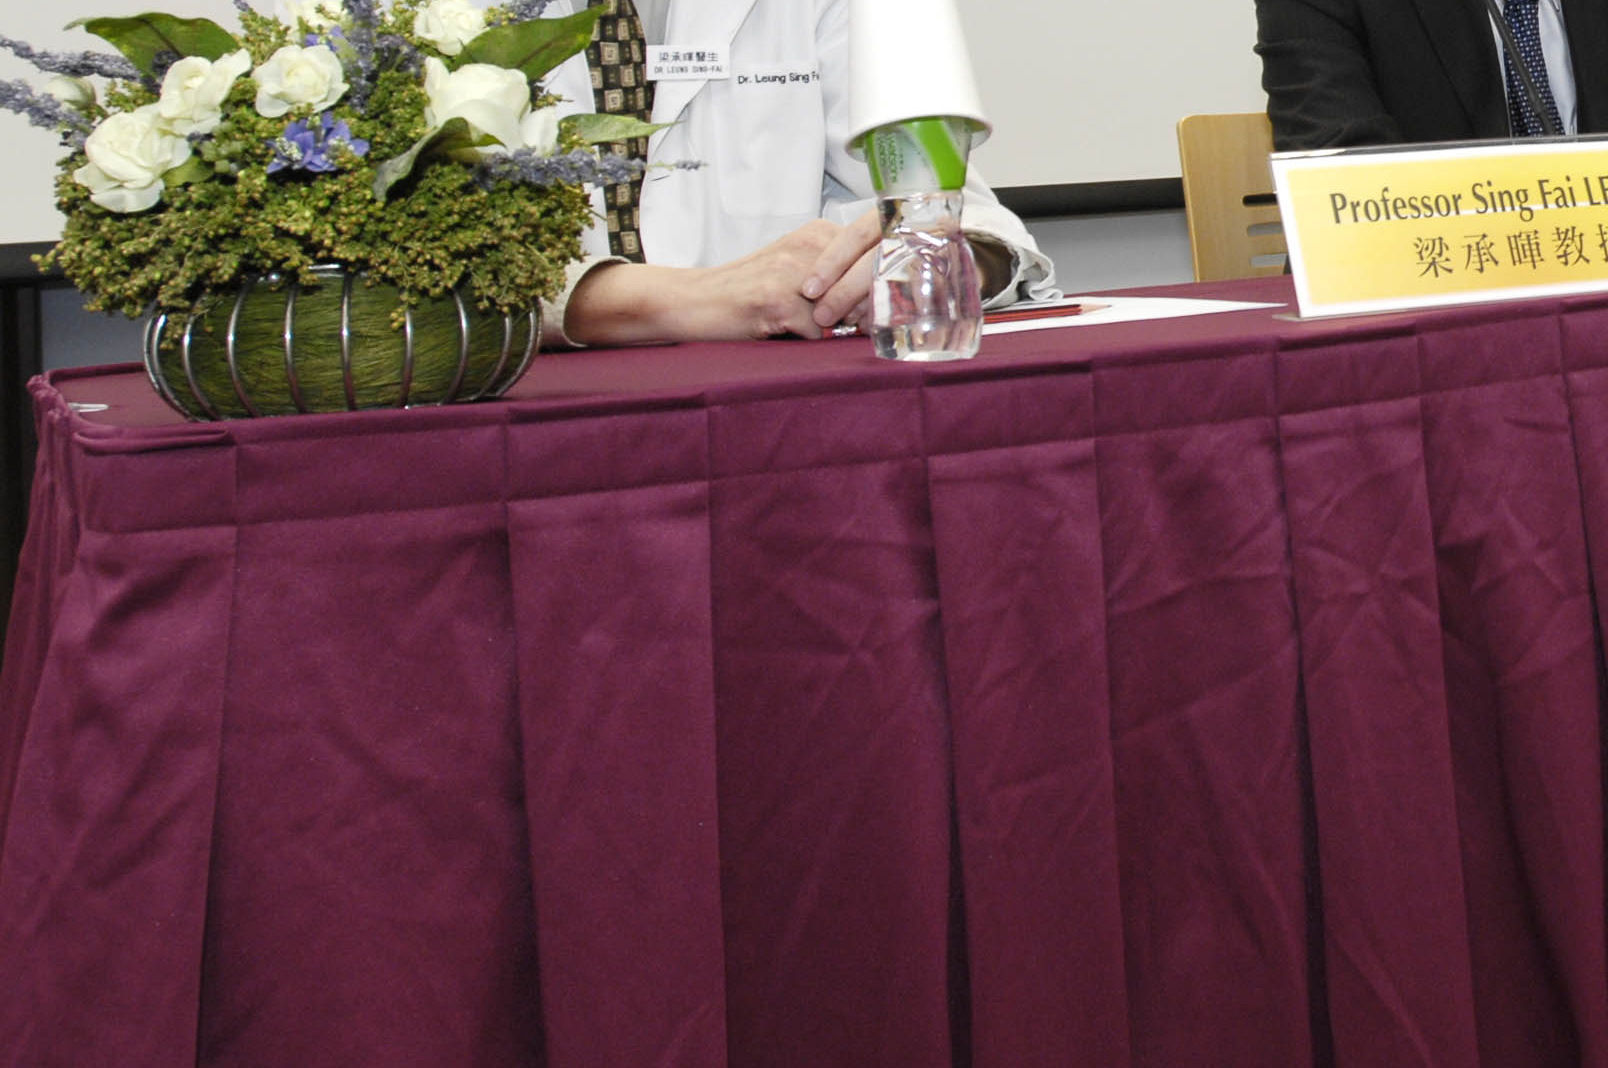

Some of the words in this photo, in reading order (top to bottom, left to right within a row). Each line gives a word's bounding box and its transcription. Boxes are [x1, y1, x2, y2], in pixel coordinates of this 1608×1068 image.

[737, 74, 751, 85] Dr.
[754, 73, 786, 85] Leung
[788, 71, 810, 84] Sing
[1330, 186, 1462, 224] Professor
[1472, 179, 1534, 222] Sing
[1537, 175, 1577, 209] Fai
